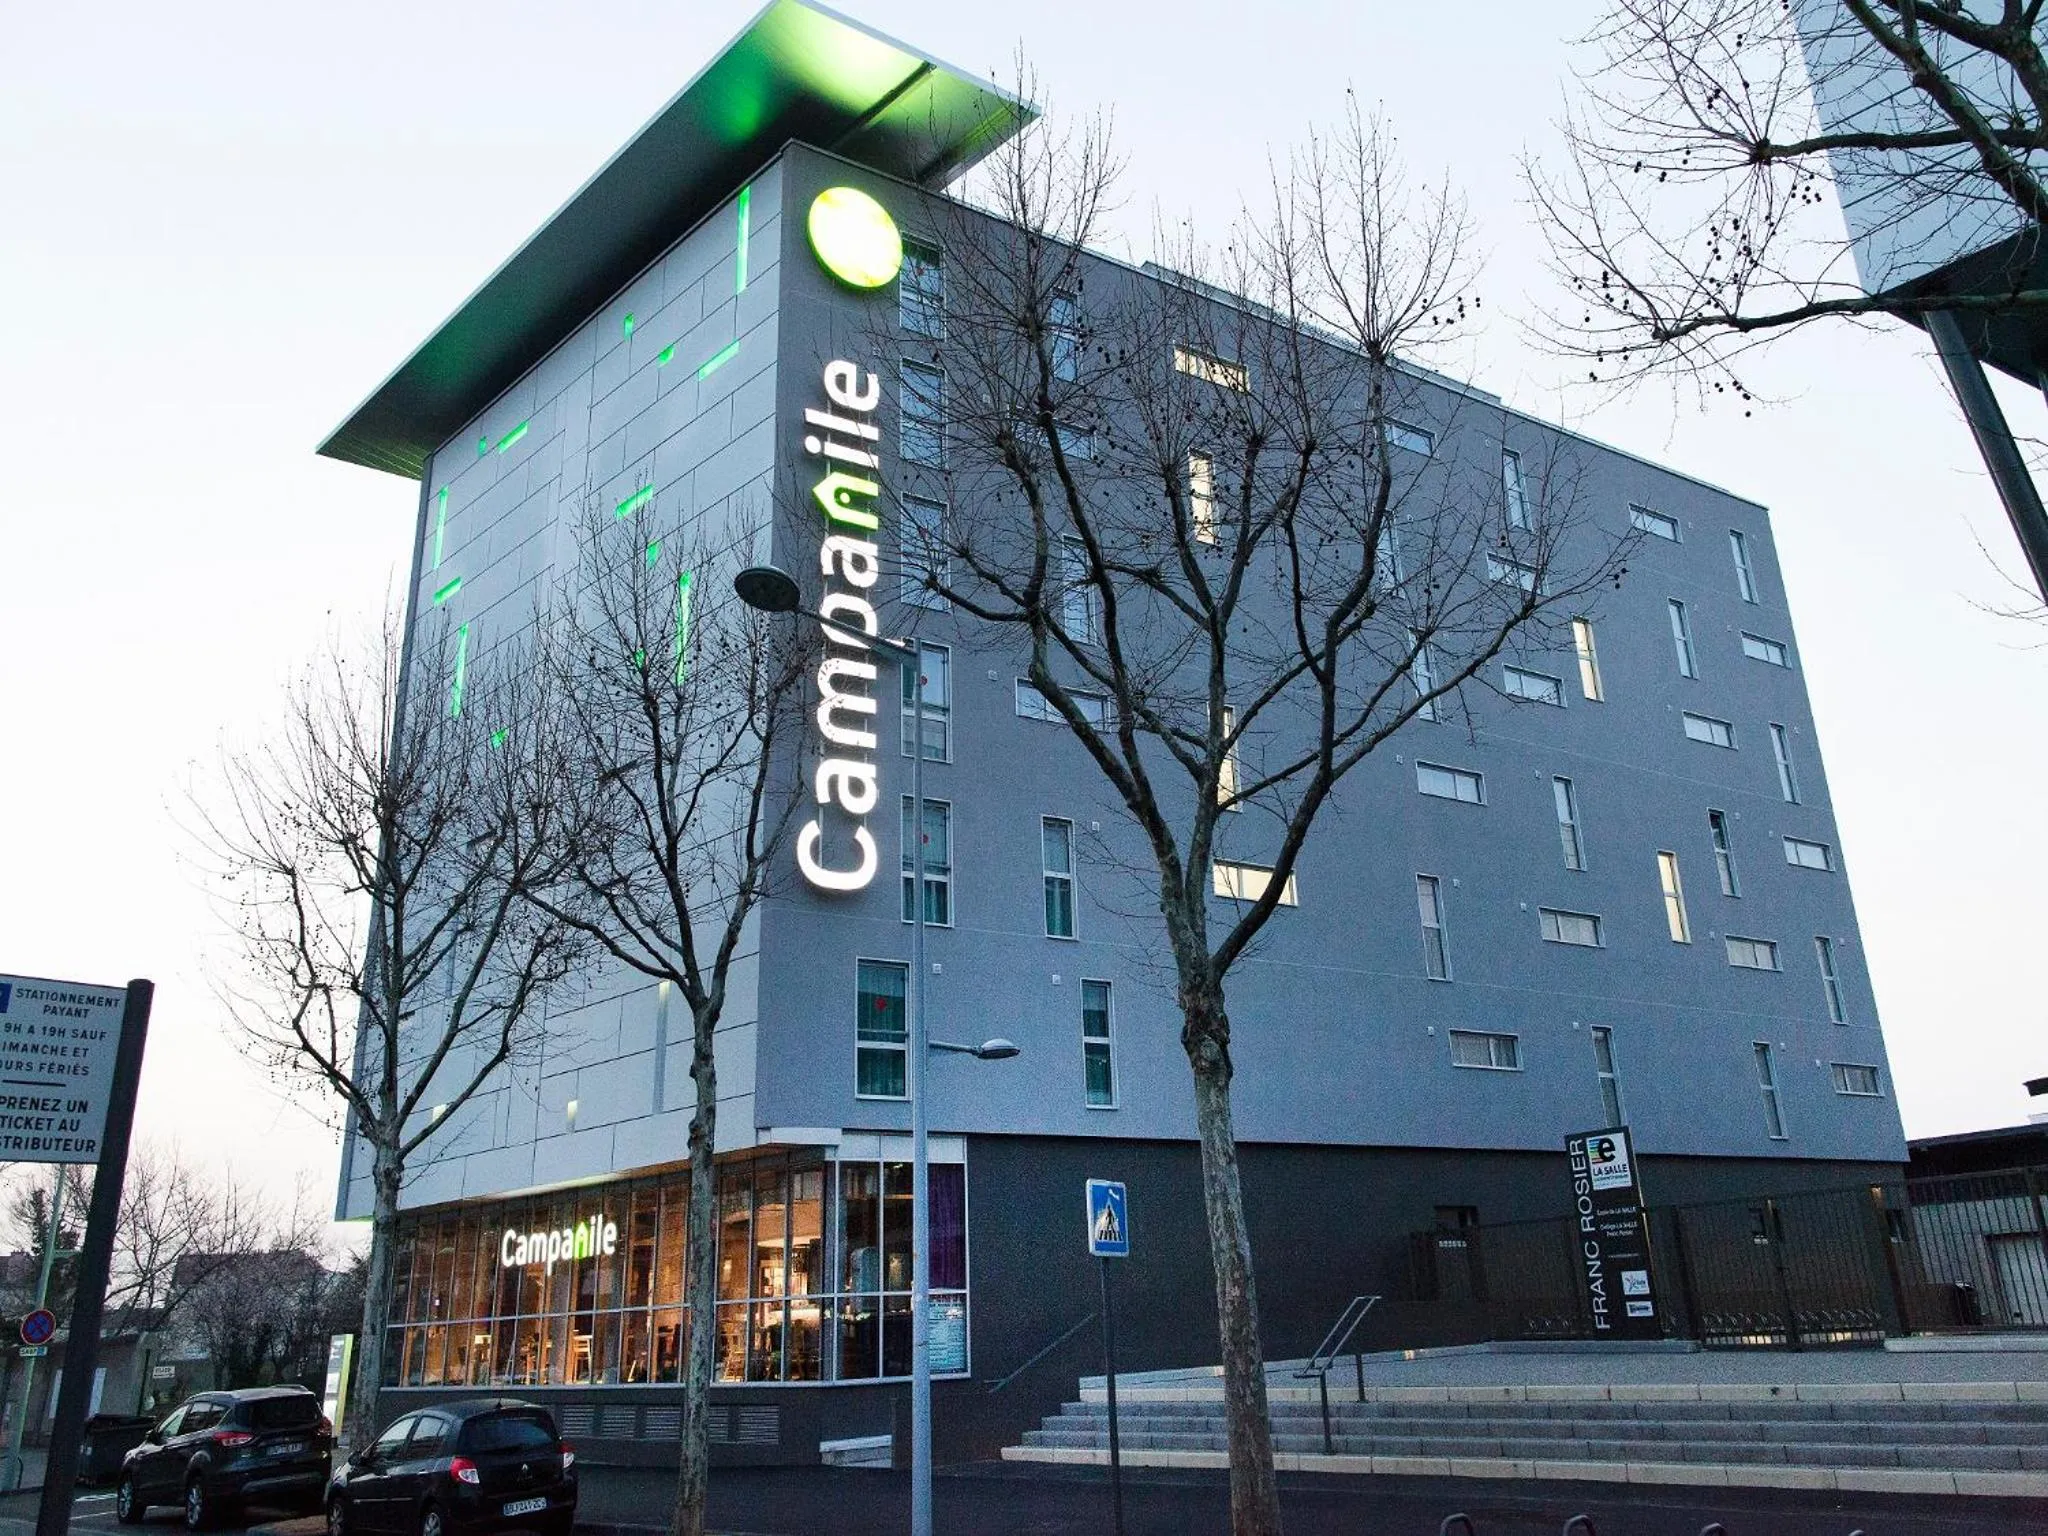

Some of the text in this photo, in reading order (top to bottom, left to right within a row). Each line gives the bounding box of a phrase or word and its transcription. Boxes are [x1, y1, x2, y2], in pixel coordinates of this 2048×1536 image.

[797, 359, 880, 892] Campanile
[16, 988, 120, 1008] STATIONNEMENT
[43, 1004, 91, 1019] PAYANT
[4, 1022, 107, 1042] 9H A 19H SAUF
[73, 1047, 90, 1058] ET
[38, 1061, 90, 1077] FÉRIÉS
[0, 1095, 89, 1114] PRENEZ UN
[0, 1115, 81, 1133] TICKET AU
[0, 1134, 96, 1153] TRIBUTEUR
[1592, 1164, 1628, 1177] LA SALLE
[1570, 1138, 1596, 1232] ROSIER
[501, 1213, 617, 1277] Campanile
[1584, 1240, 1611, 1330] FRANC
